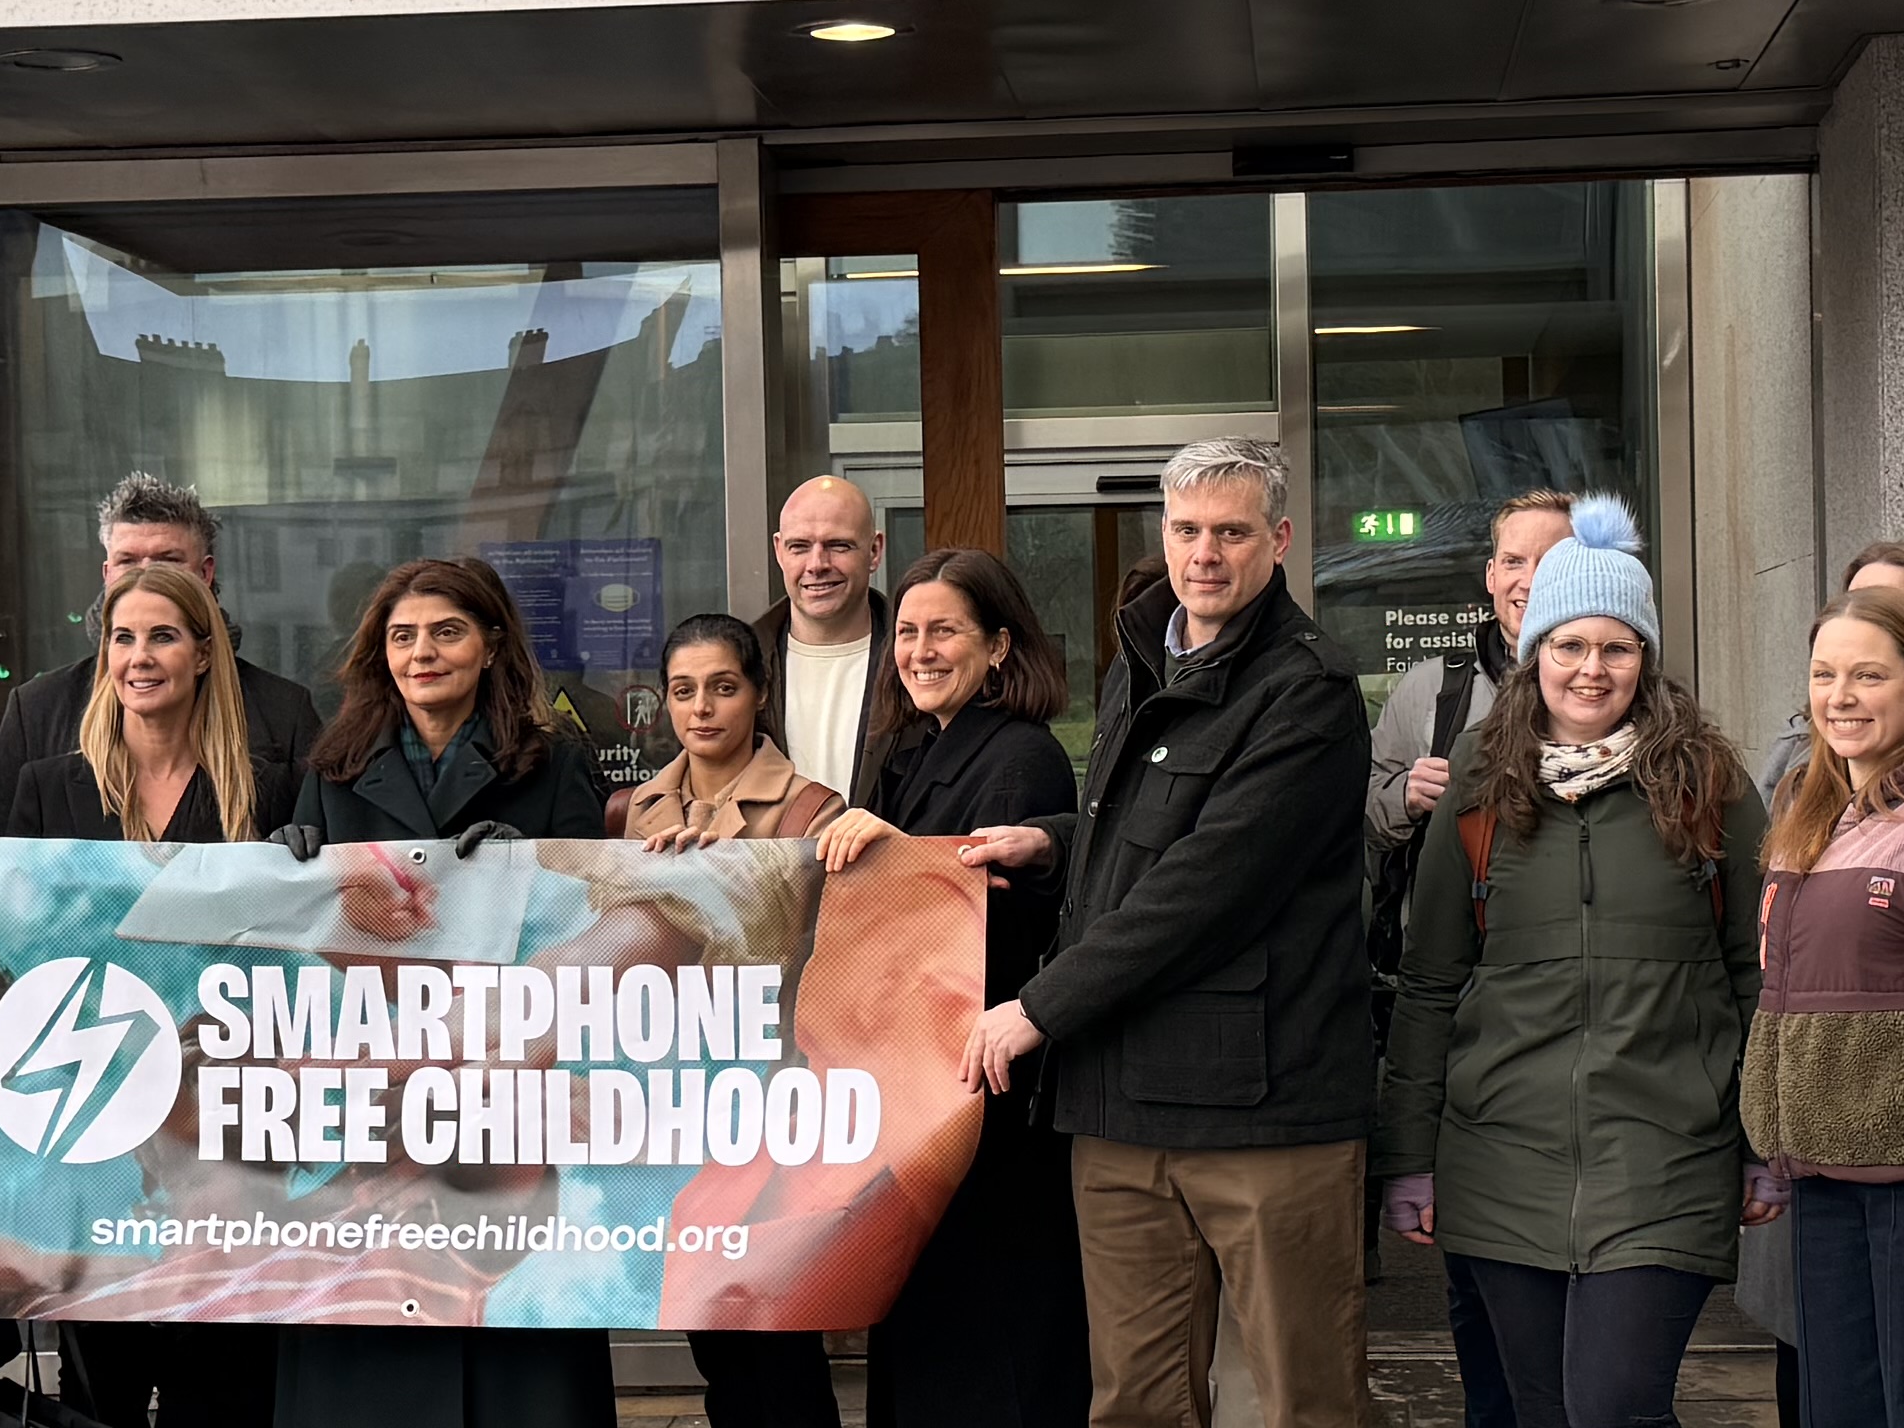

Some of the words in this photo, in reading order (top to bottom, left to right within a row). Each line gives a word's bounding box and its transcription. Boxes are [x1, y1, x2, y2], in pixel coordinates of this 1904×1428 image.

[1385, 609, 1449, 626] Please
[1456, 607, 1490, 624] ask
[1385, 632, 1413, 649] for
[1420, 632, 1474, 648] assist
[198, 961, 782, 1063] SMARTPHONE
[198, 1067, 388, 1162] FREE
[402, 1064, 883, 1165] CHILDHOOD
[90, 1213, 750, 1260] smartphonefreechildhood.org
